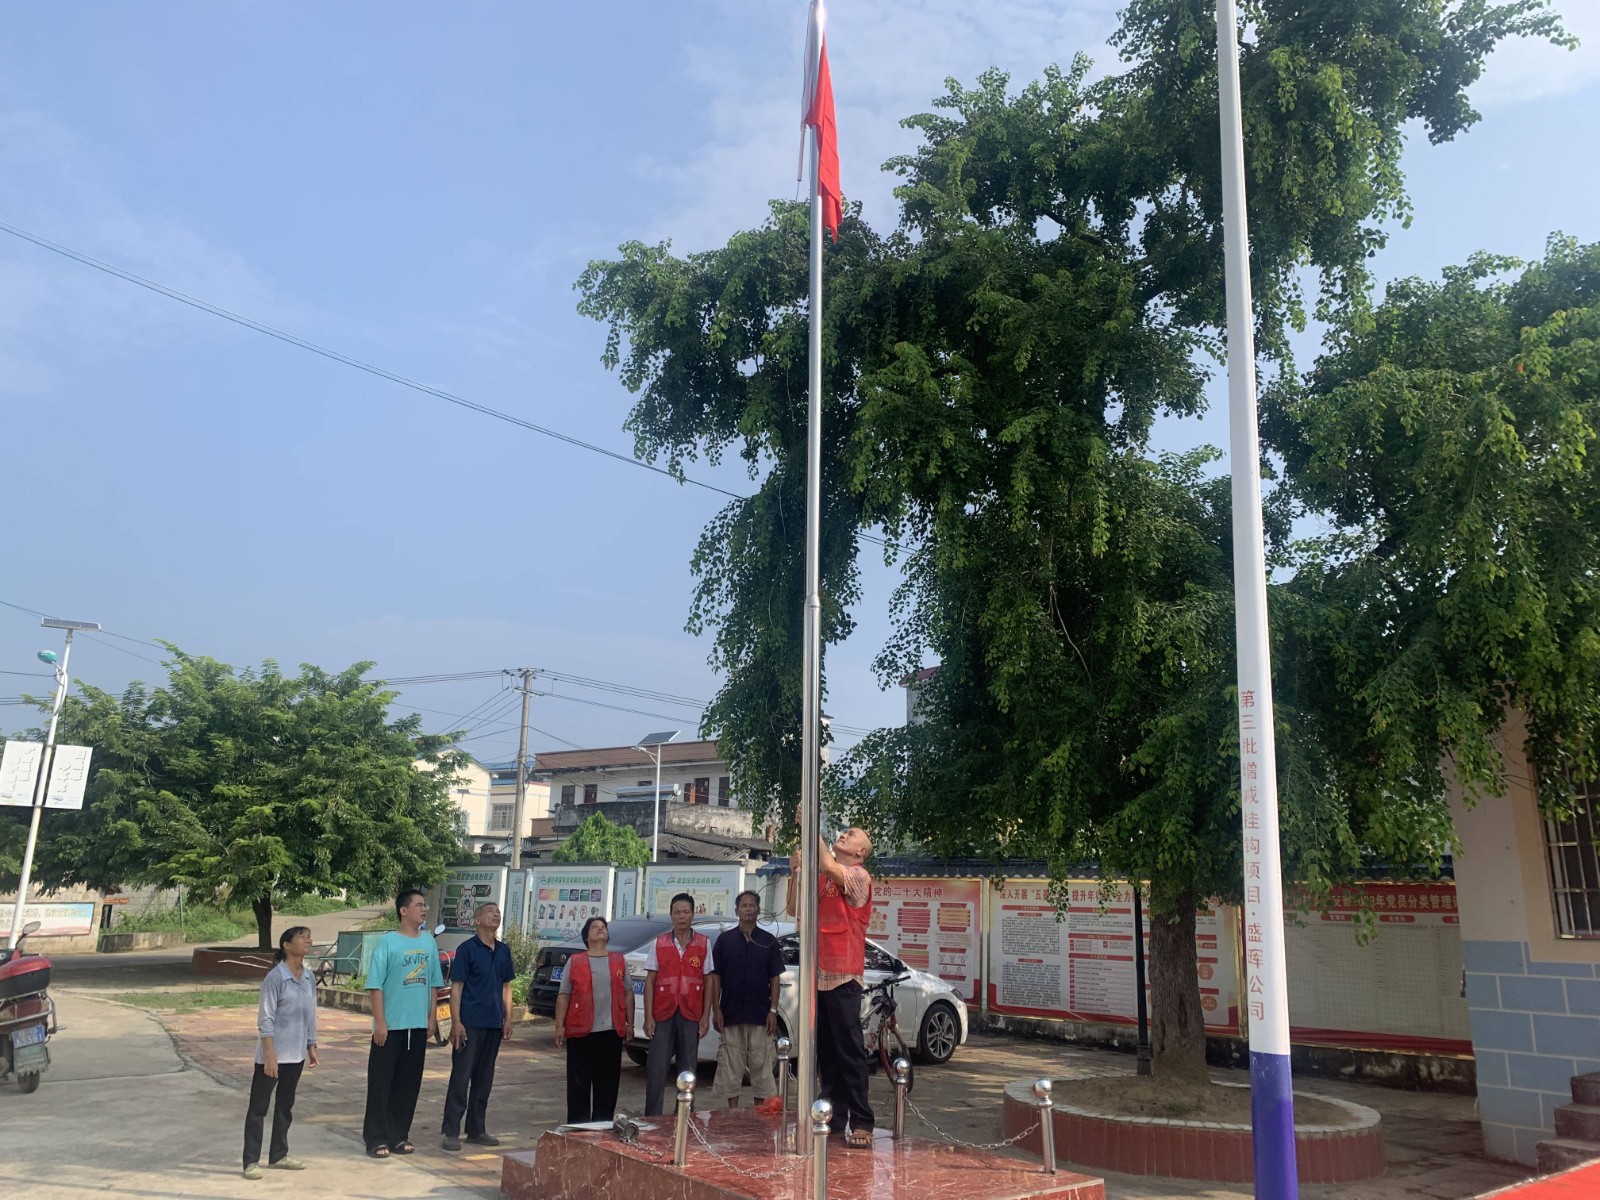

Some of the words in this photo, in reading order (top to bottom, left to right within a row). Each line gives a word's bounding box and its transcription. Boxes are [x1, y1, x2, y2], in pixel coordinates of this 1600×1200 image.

[873, 886, 944, 899] 党的二十大精神
